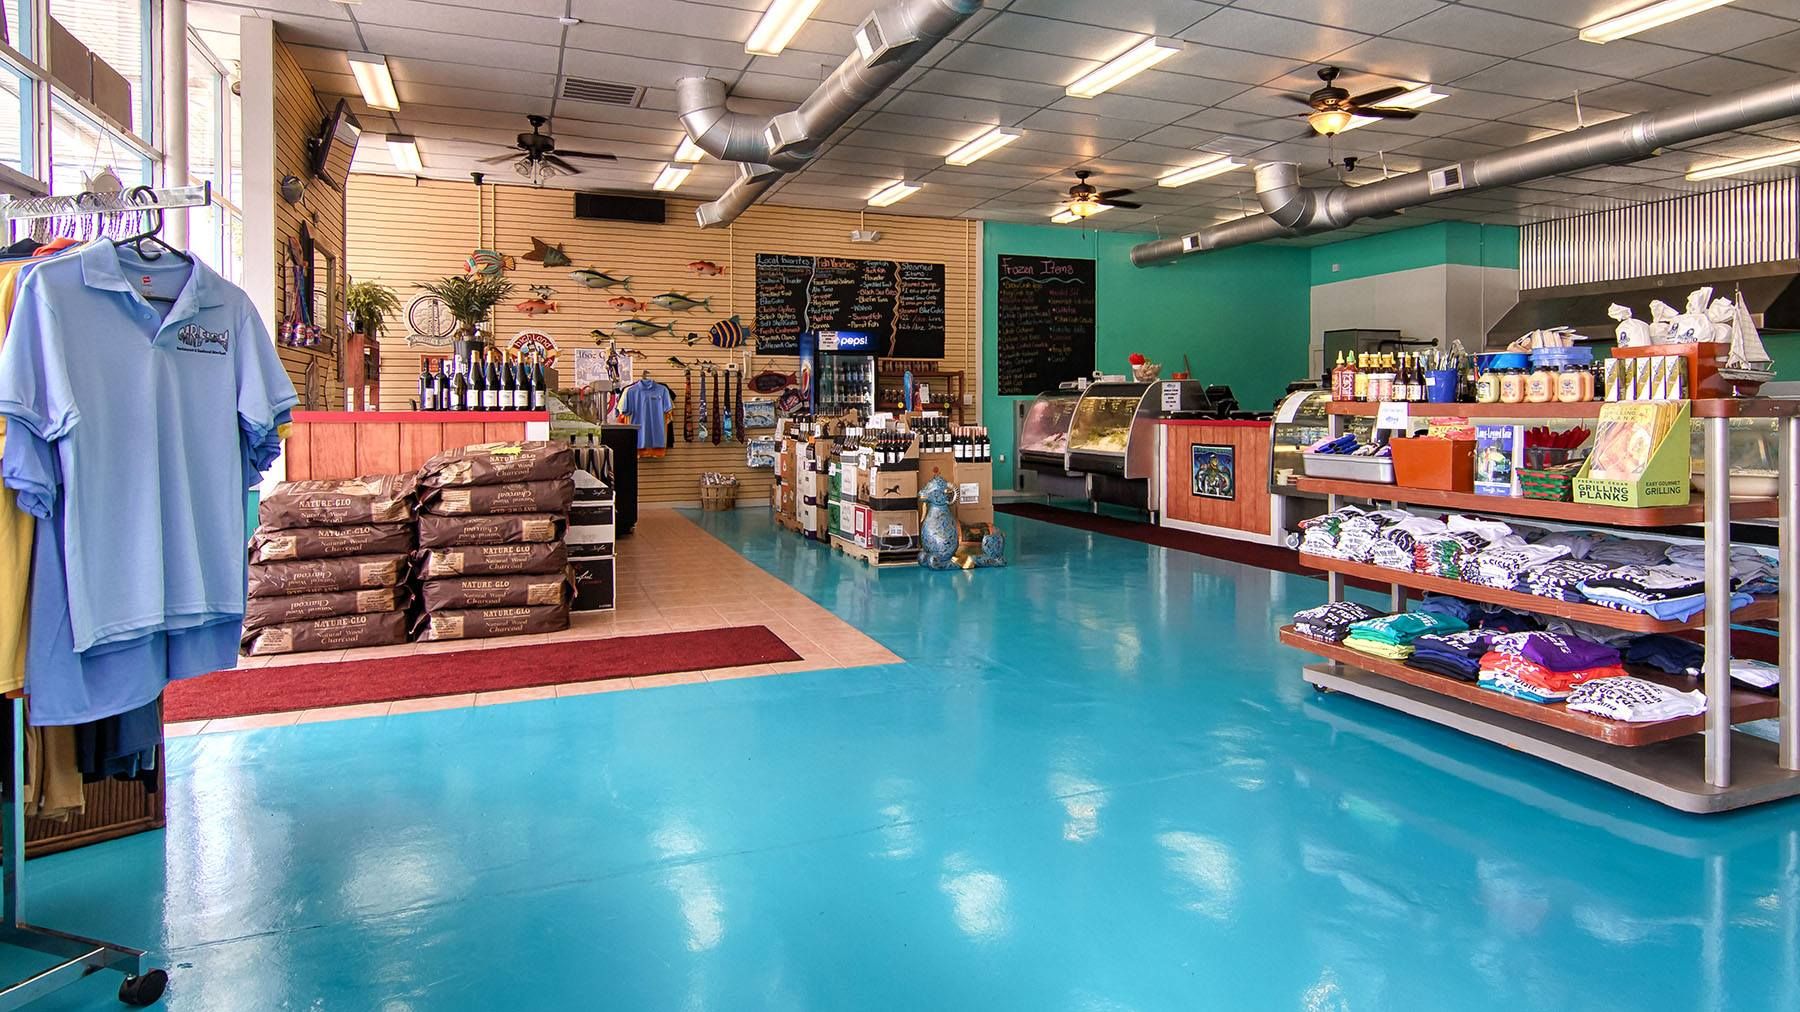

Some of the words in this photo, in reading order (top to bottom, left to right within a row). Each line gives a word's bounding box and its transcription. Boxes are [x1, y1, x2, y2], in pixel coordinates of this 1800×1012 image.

[758, 254, 779, 264] Local
[902, 262, 932, 270] Steamed
[1002, 257, 1034, 274] Frozen
[1040, 260, 1074, 275] Items
[840, 336, 868, 346] pepsi
[498, 490, 532, 498] Charcoal
[1578, 484, 1628, 494] GRILLING
[1645, 487, 1680, 496] GRILLING
[1580, 491, 1628, 502] PLANKS
[294, 572, 332, 580] Charcoal
[290, 600, 330, 610] Charcoal
[321, 636, 359, 644] Charcoal
